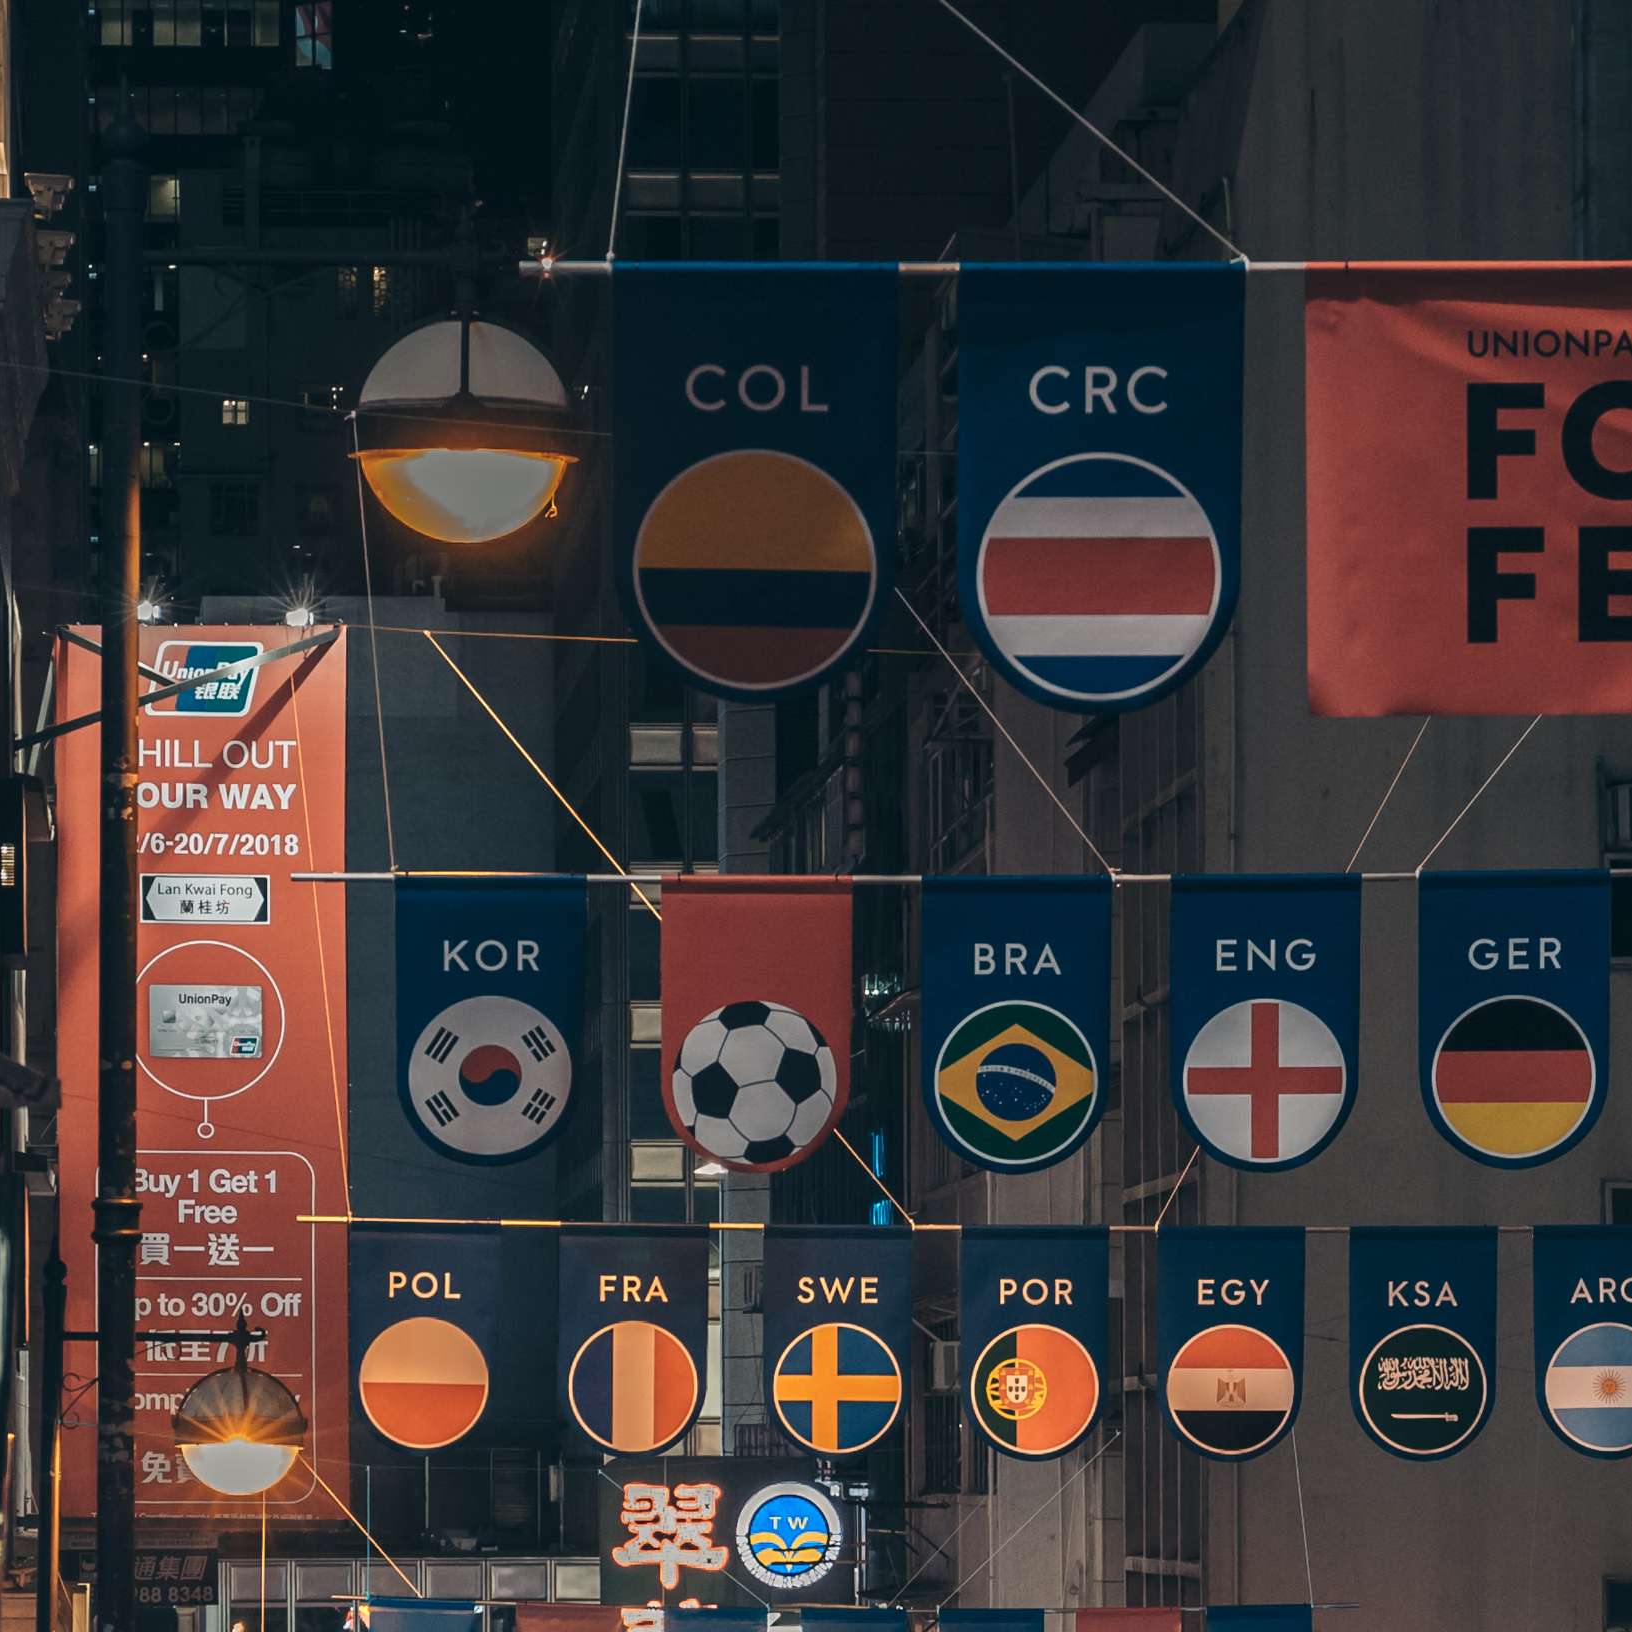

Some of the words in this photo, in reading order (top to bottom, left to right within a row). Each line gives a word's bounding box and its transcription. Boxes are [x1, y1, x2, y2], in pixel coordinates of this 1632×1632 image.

[684, 365, 830, 413] COL
[1029, 365, 1169, 415] CRC
[195, 682, 241, 700] 银联
[137, 739, 213, 769] HILL
[223, 740, 297, 770] OUT
[136, 783, 208, 810] OUR
[219, 784, 297, 810] WAY
[157, 883, 181, 896] Lan
[185, 883, 217, 896] Kwai
[220, 884, 253, 900] Fong
[179, 899, 230, 915] 蘭桂坊
[442, 940, 540, 972] KOR
[972, 943, 1062, 977] BRA
[1214, 938, 1318, 972] ENG
[1467, 937, 1563, 971] GER
[178, 993, 232, 1009] UnionPay
[135, 1169, 181, 1199] Buy
[187, 1169, 200, 1193] 1
[208, 1168, 258, 1193] Get
[265, 1169, 277, 1193] 1
[177, 1200, 238, 1225] Free
[140, 1233, 275, 1267] 買一送一
[388, 1271, 462, 1301] POL
[598, 1274, 669, 1303] FRA
[797, 1276, 880, 1304] SWE
[998, 1278, 1074, 1306] POR
[1196, 1278, 1271, 1308] EGY
[1386, 1280, 1460, 1309] KSA
[135, 1297, 152, 1325] p
[159, 1296, 186, 1318] to
[191, 1292, 253, 1318] 30%
[260, 1292, 302, 1318] Off
[167, 1583, 215, 1603] 8348
